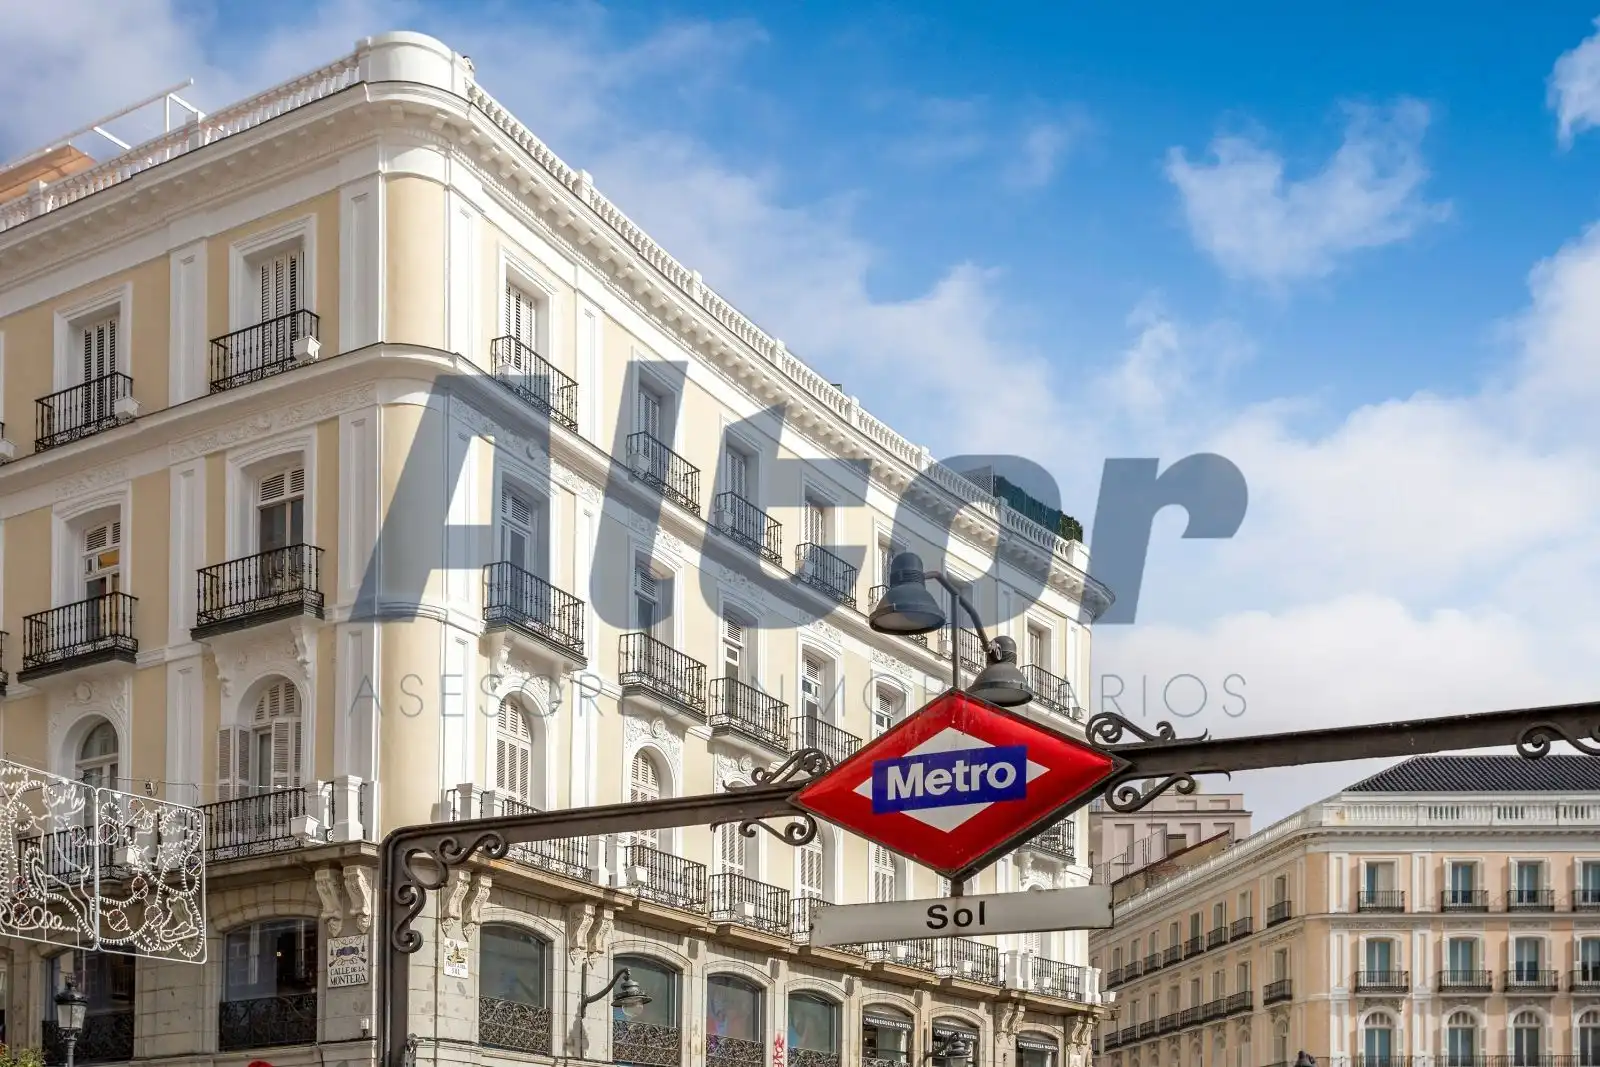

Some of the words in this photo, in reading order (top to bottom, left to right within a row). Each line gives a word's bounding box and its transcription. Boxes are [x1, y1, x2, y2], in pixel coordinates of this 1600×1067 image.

[887, 760, 1017, 801] Metro
[926, 901, 986, 930] Sol
[330, 967, 350, 976] CALLE
[330, 973, 367, 986] MONTERA
